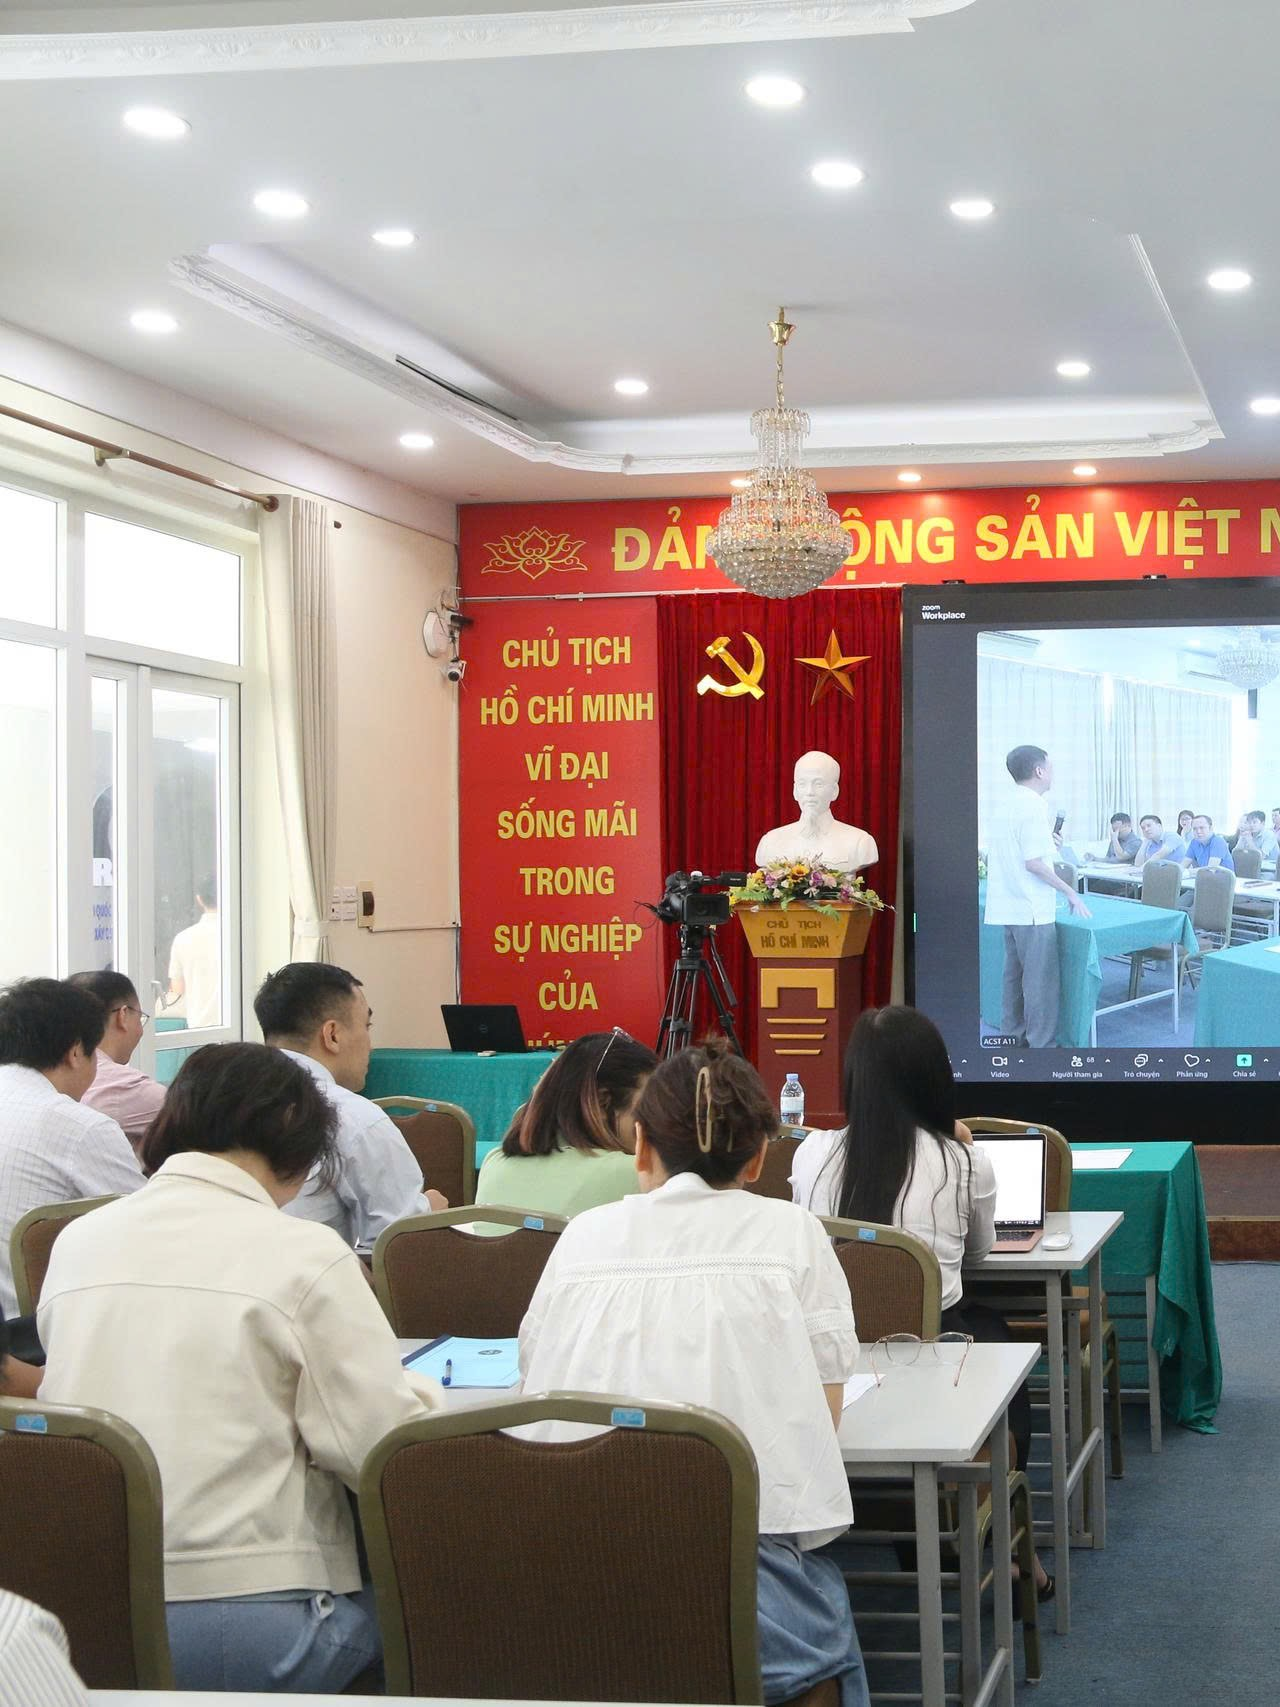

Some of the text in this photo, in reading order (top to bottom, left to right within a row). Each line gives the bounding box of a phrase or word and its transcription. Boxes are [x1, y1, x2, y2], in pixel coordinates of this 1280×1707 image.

[841, 506, 956, 582] ỘNG
[975, 493, 1096, 562] SẢN
[1114, 496, 1241, 570] VIỆT
[921, 611, 966, 620] Workplace
[502, 626, 631, 674] CHỦ TỊCH
[481, 684, 654, 725] HỒ CHÍ MINH
[524, 744, 609, 789] VĨ ĐẠI
[498, 797, 637, 839] SỐNG MÃI
[519, 866, 615, 896] TRONG
[494, 915, 643, 963] SỰ NGHIỆP
[766, 919, 822, 931] CHỦ TỊCH
[801, 935, 829, 948] MINH
[539, 969, 598, 1011] CỦA
